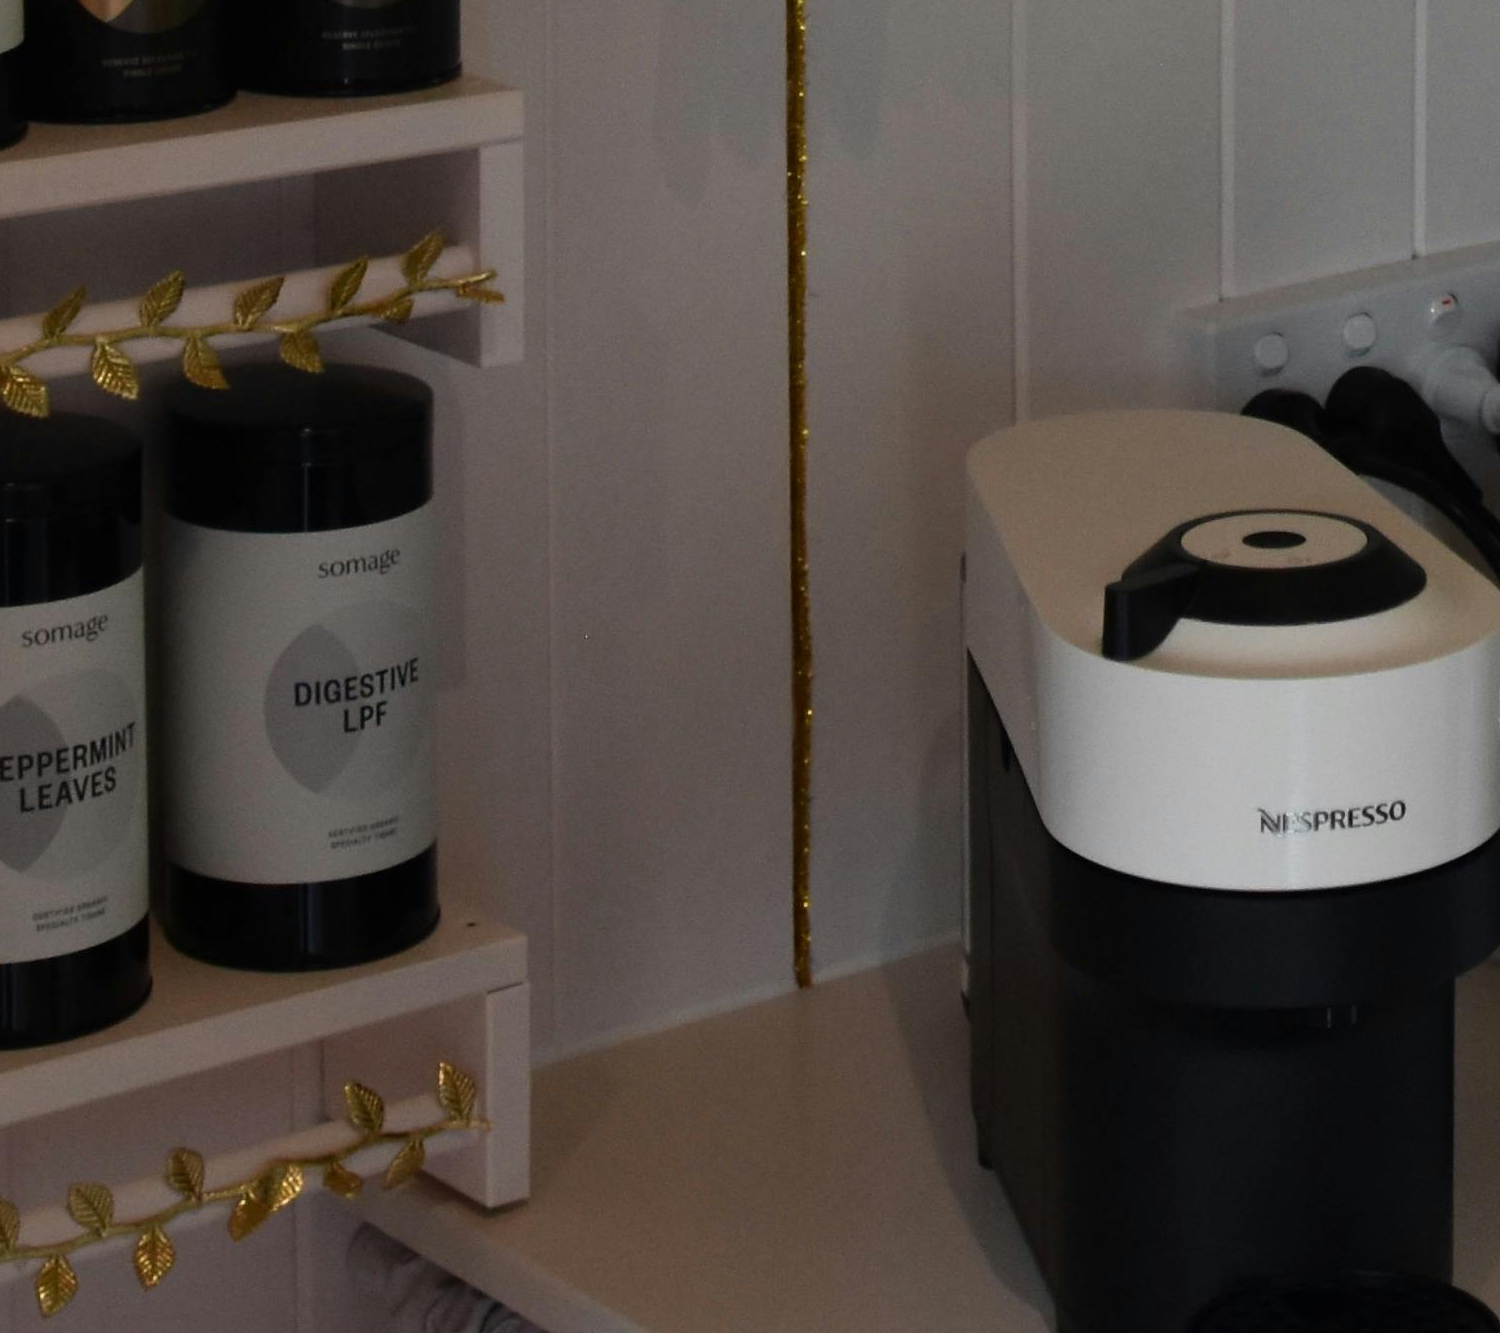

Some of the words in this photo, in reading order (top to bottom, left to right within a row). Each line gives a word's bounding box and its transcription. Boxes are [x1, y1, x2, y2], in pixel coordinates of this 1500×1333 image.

[318, 548, 400, 579] somage
[21, 614, 110, 649] somage
[293, 656, 420, 708] DIGESTIVE
[343, 699, 389, 734] LPF
[19, 765, 118, 813] LEAVES
[1256, 798, 1407, 836] NESPRESSO
